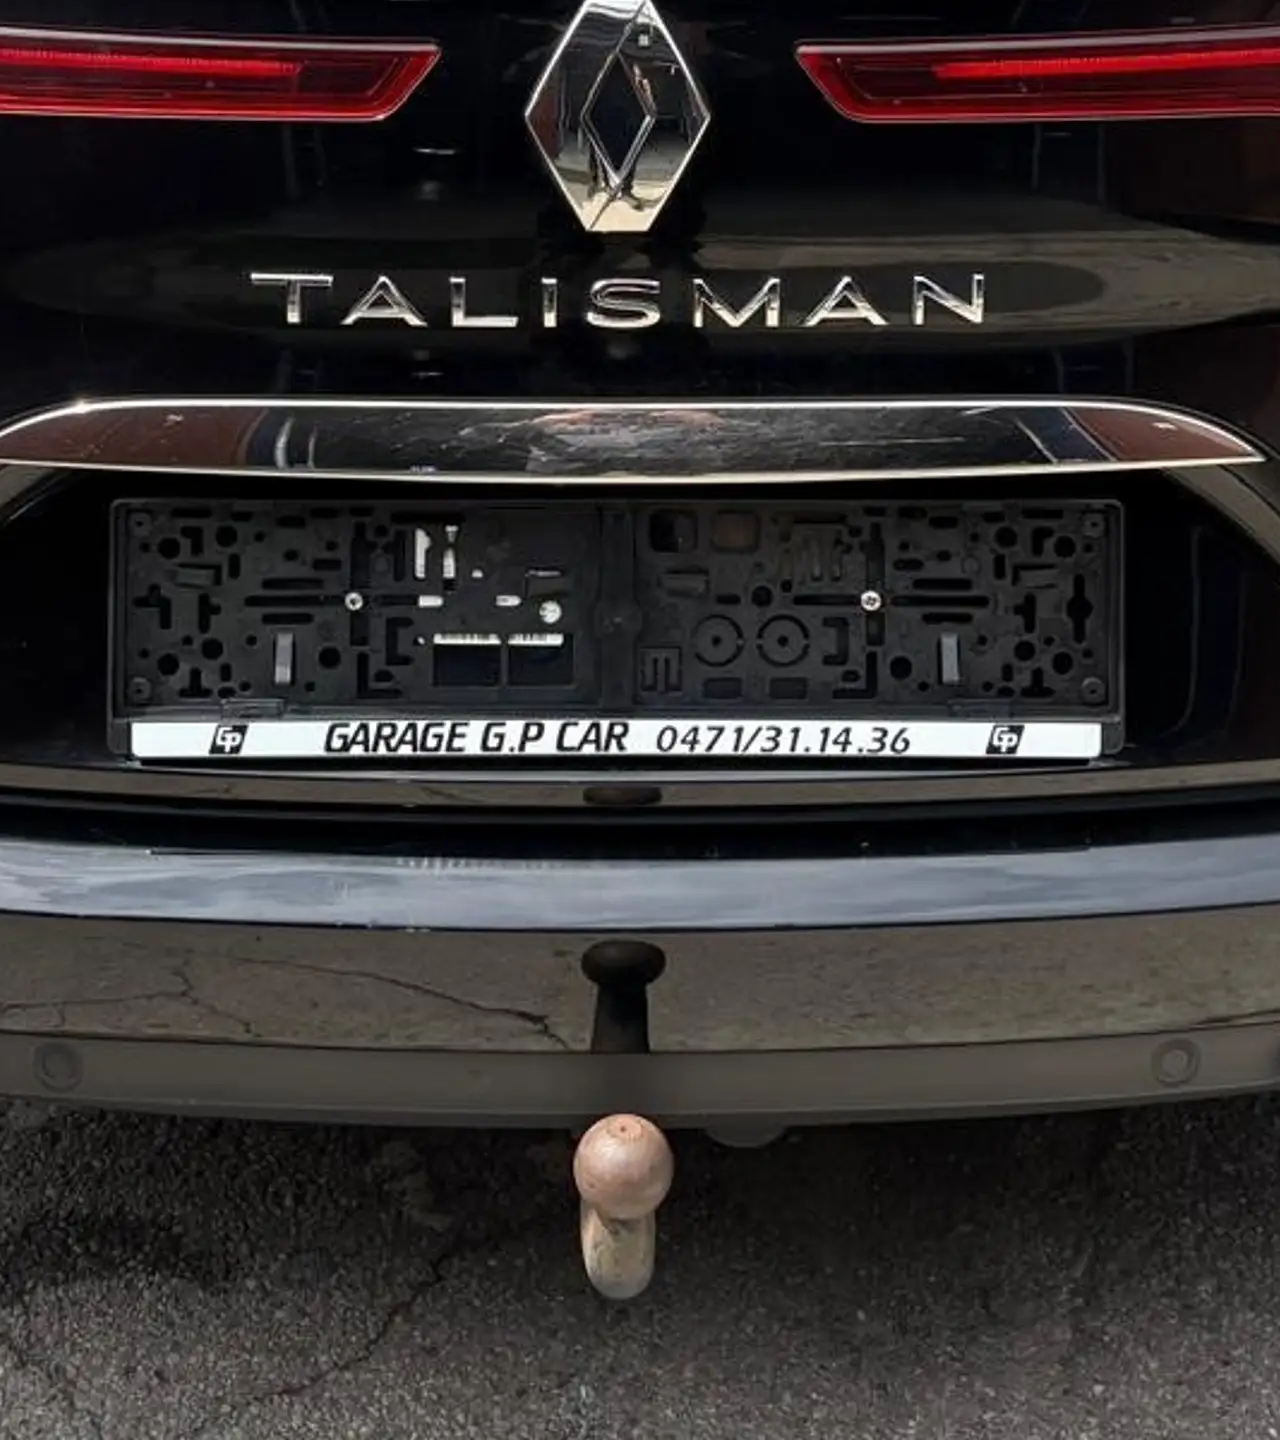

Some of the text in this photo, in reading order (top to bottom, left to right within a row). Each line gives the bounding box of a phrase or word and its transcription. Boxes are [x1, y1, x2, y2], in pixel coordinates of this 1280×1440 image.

[250, 271, 985, 328] TALISMAN
[324, 722, 469, 753] GARAGE
[479, 722, 546, 753] G.P
[555, 722, 630, 753] CAR
[656, 725, 912, 754] 0471/31.14.36
